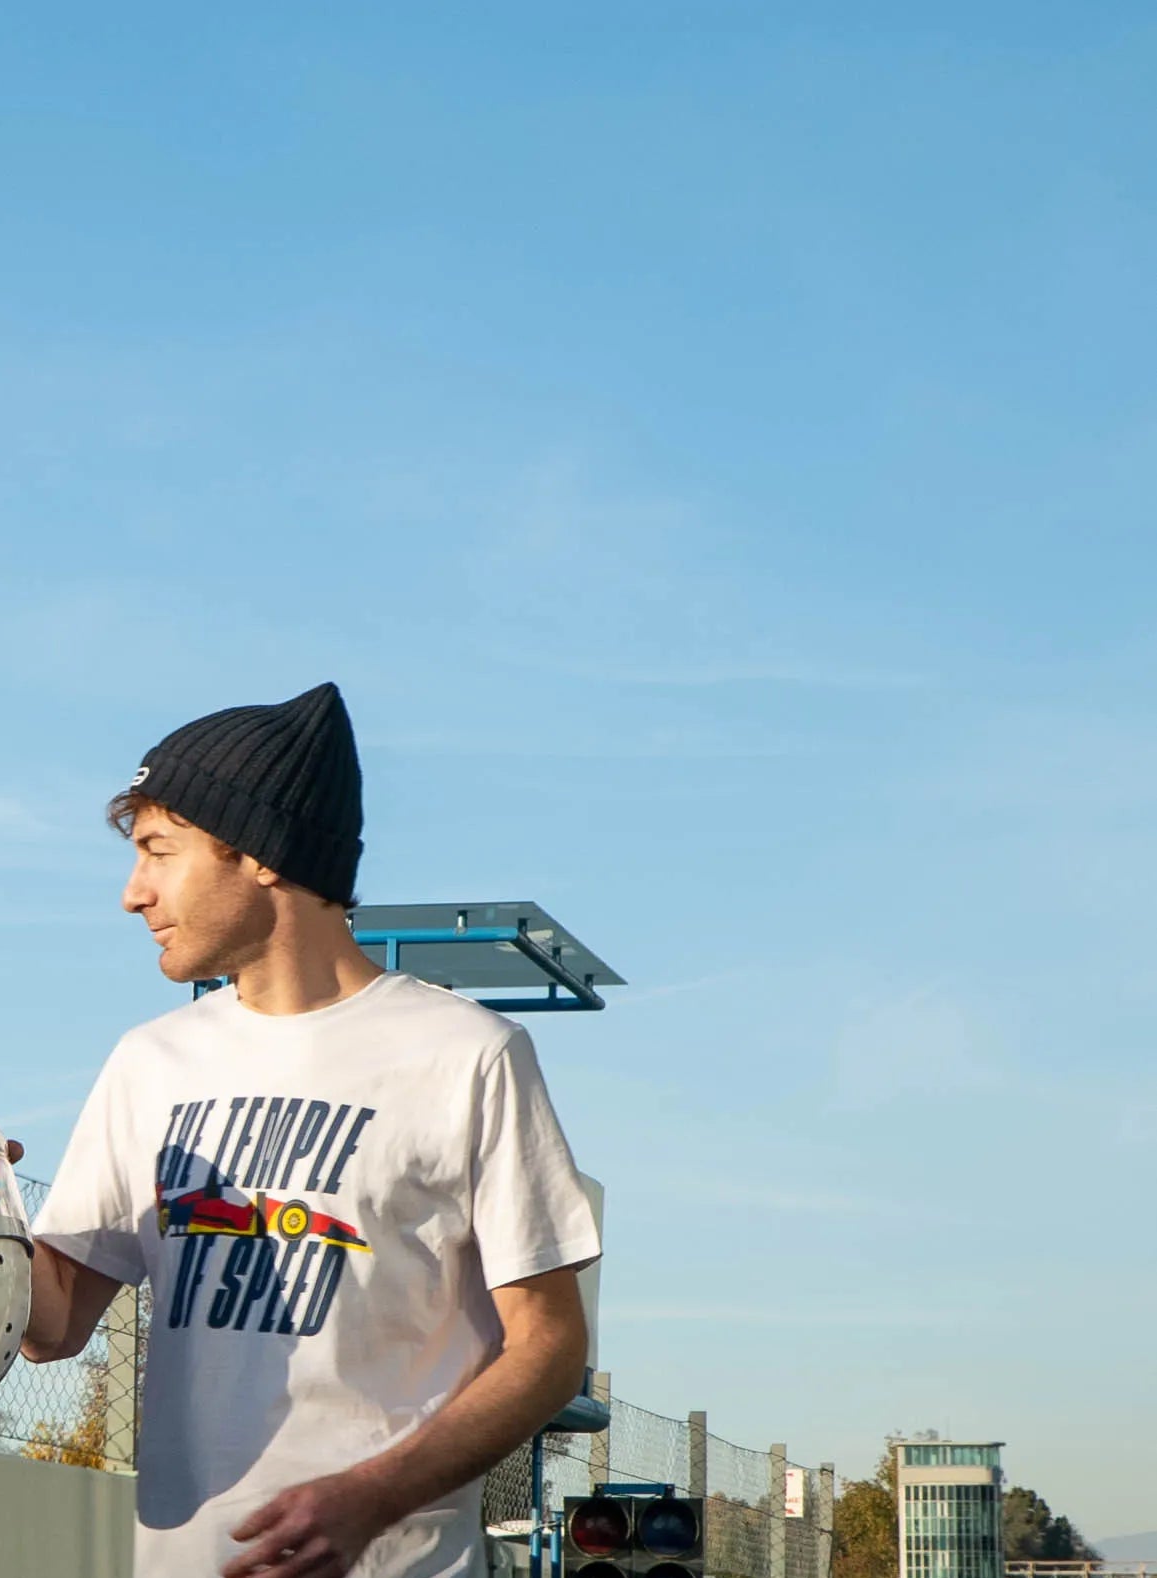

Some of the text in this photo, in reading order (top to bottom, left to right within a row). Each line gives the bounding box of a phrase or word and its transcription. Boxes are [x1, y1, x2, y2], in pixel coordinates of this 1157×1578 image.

[155, 1097, 377, 1195] THE TEMPLE
[168, 1235, 346, 1337] OF SPEED
